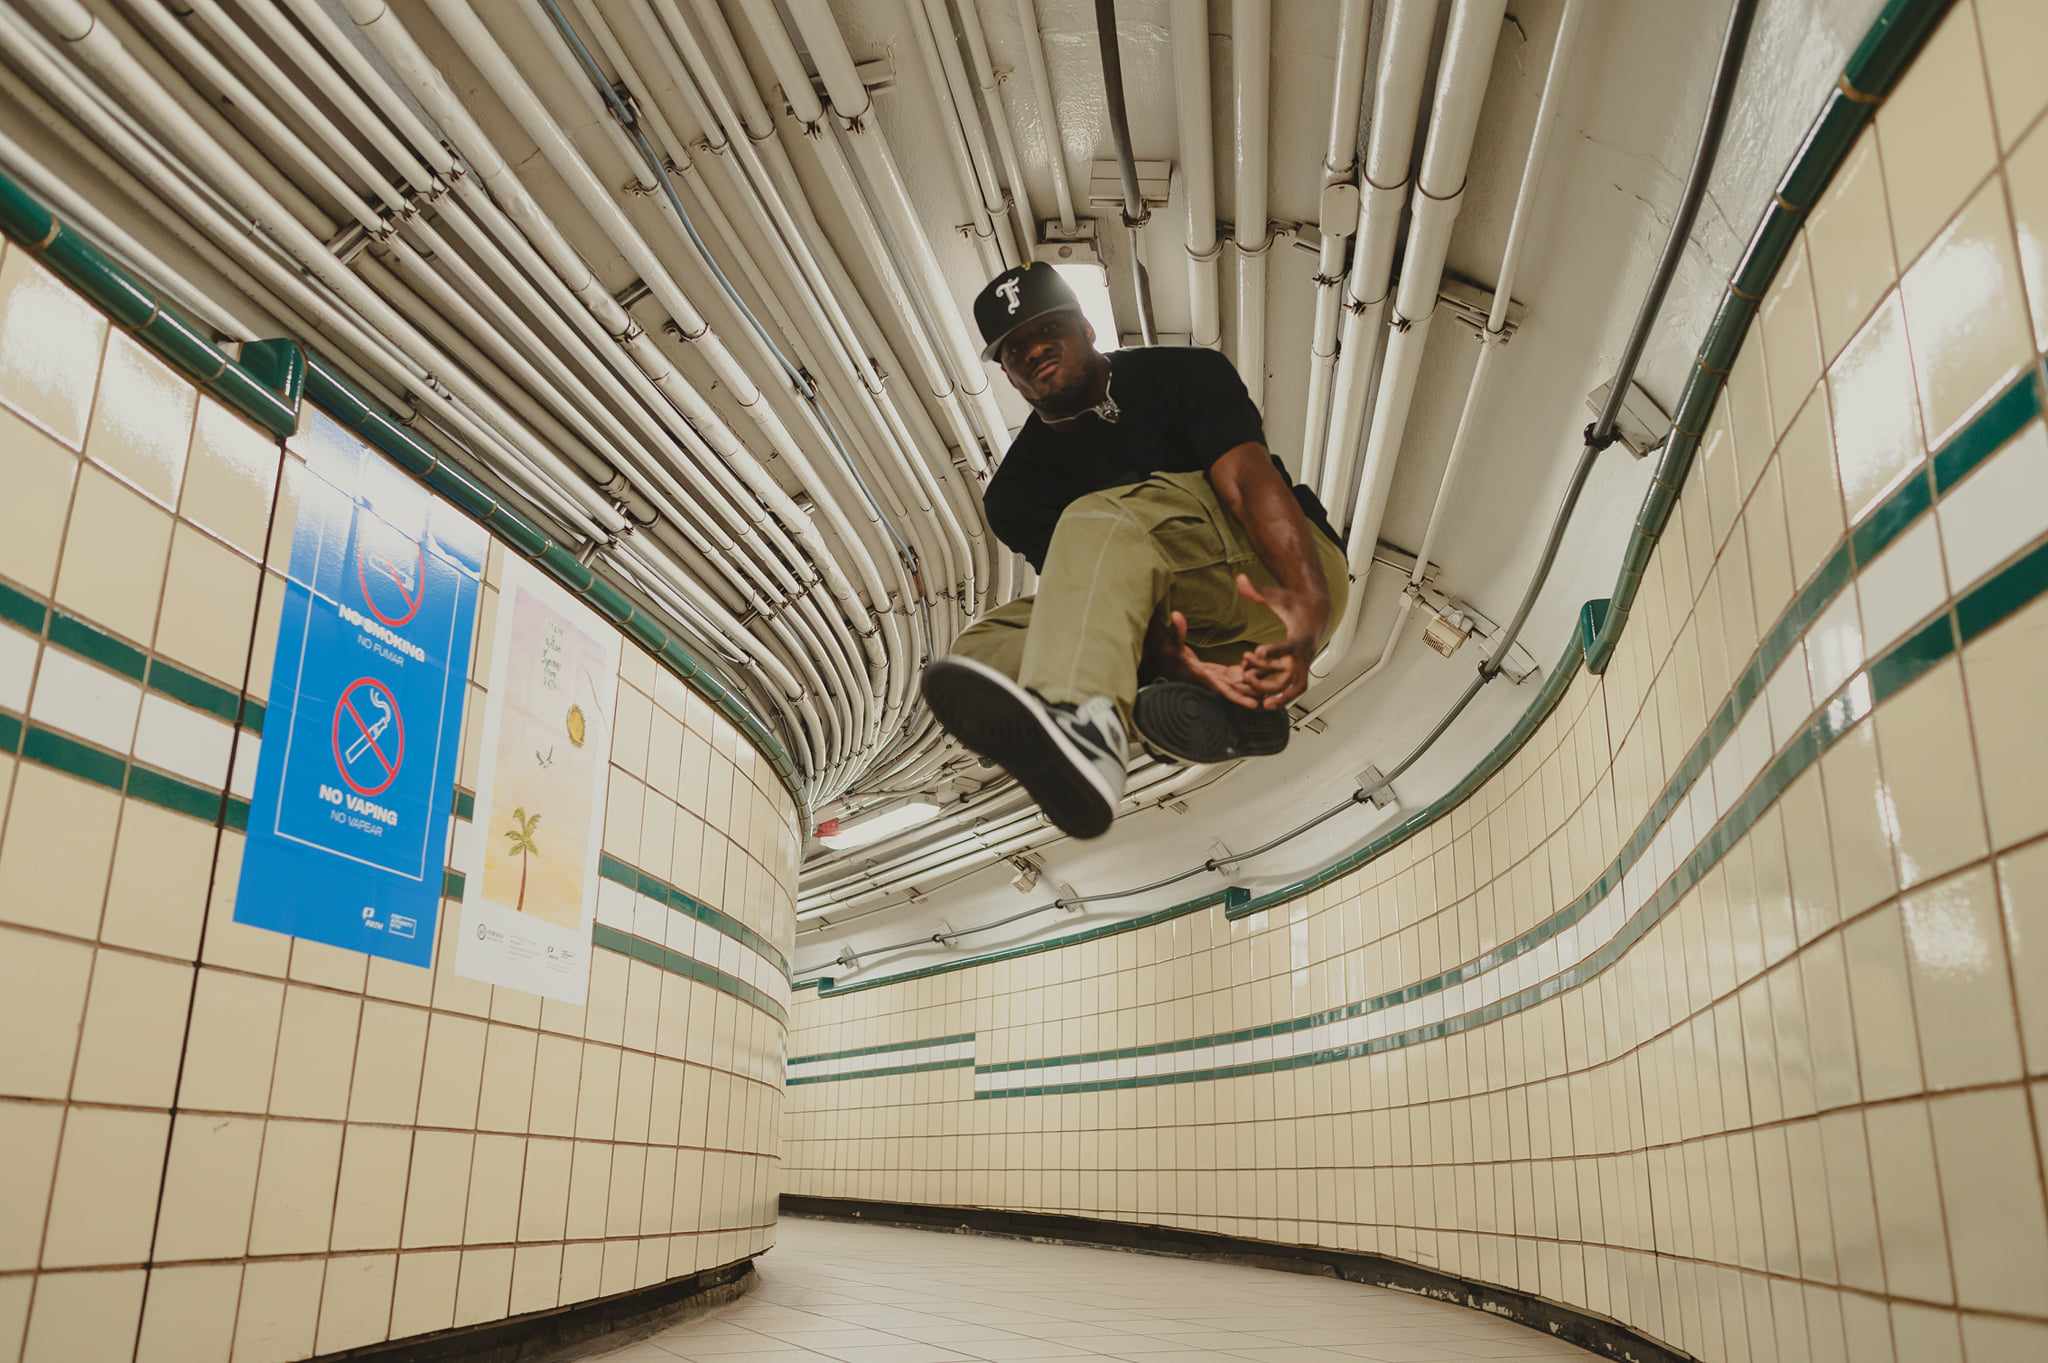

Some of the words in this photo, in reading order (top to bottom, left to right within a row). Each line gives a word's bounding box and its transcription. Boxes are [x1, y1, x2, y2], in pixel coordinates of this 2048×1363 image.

[338, 603, 362, 627] NO
[362, 615, 425, 662] SMOKING
[357, 634, 373, 649] NO
[373, 642, 404, 669] FUMAR
[319, 783, 343, 806] NO
[346, 793, 398, 828] VAPING
[330, 808, 346, 824] NO
[347, 815, 383, 837] VAPEAR
